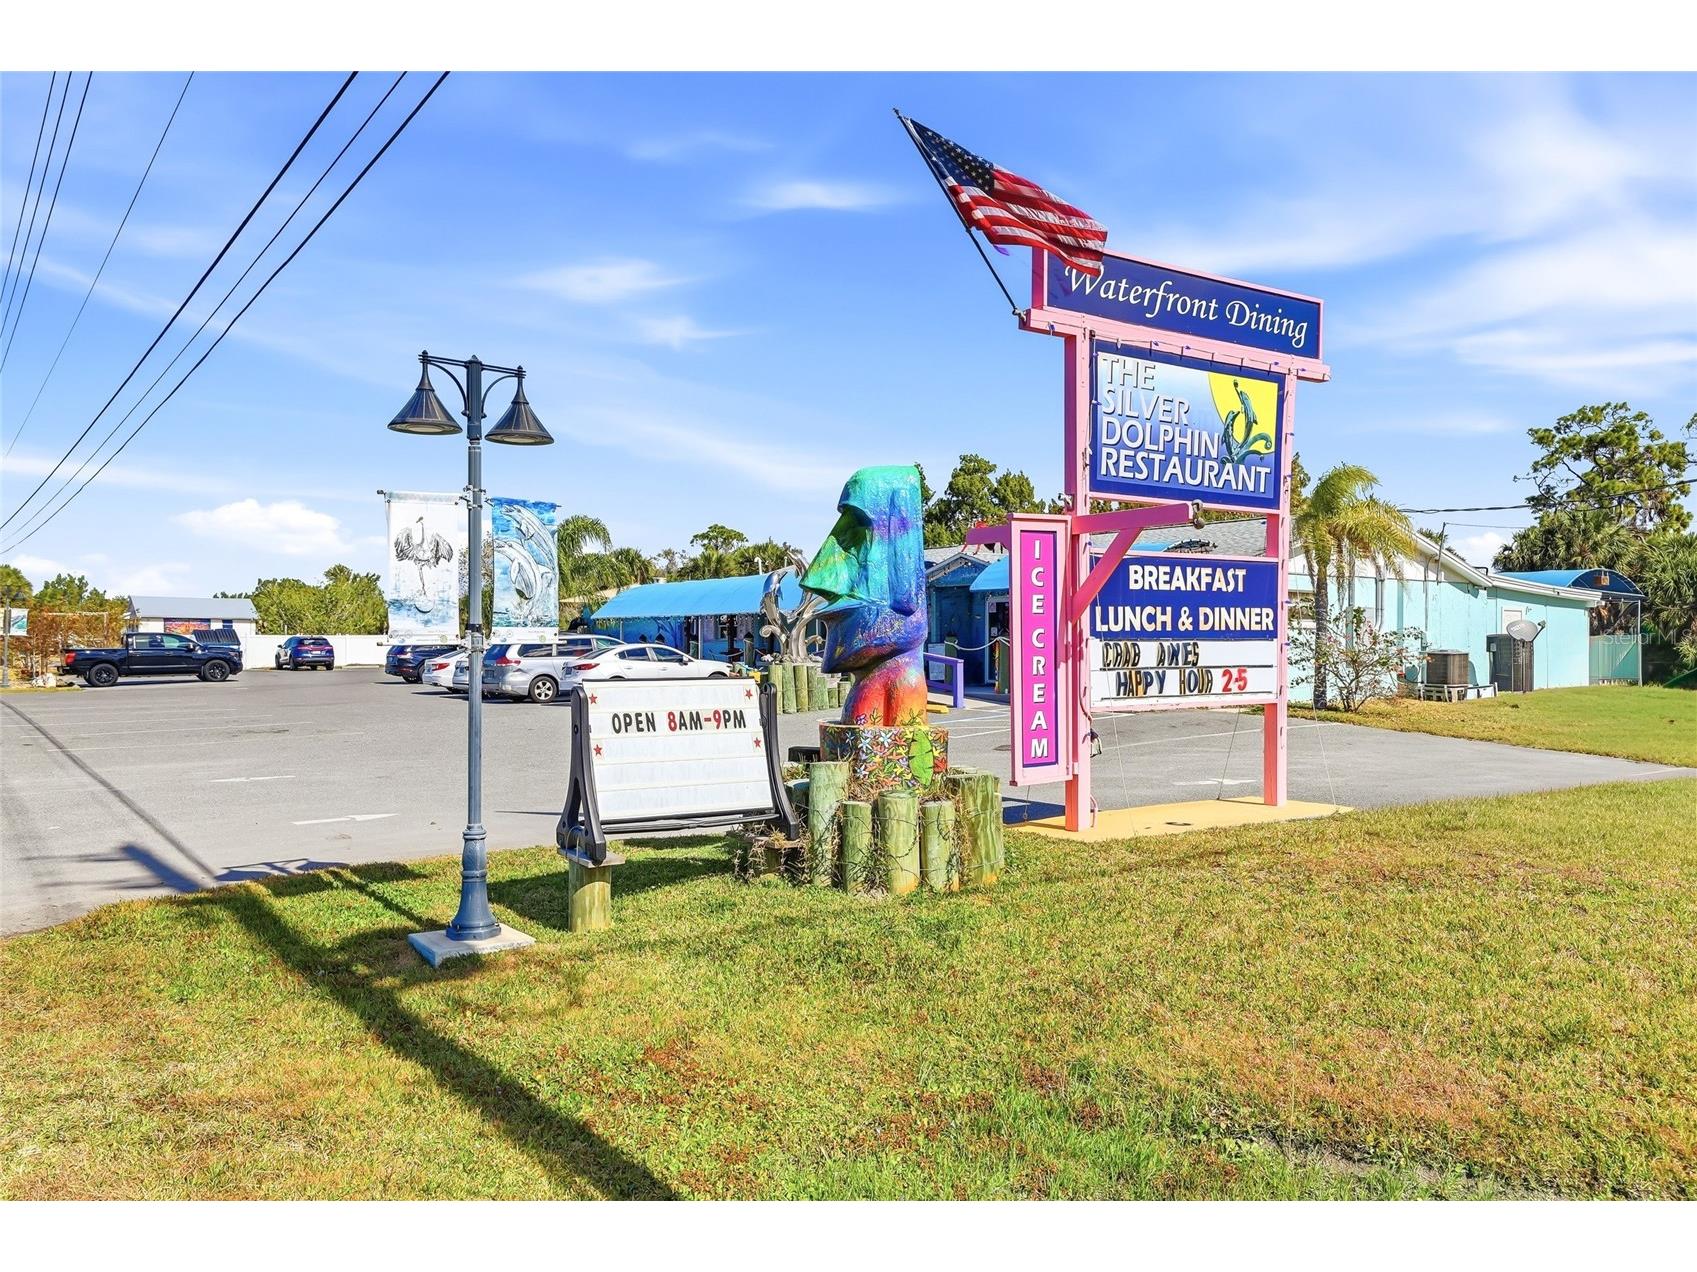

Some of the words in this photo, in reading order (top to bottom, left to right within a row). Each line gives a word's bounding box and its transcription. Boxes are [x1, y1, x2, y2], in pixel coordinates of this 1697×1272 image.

[1064, 263, 1218, 320] Waterfront
[1226, 300, 1308, 348] Dining
[1102, 357, 1156, 391] THE
[1102, 389, 1190, 426] SILVER
[1101, 417, 1220, 459] DOLPHIN
[1100, 447, 1271, 493] RESTAURANT
[1031, 539, 1045, 615] ICE
[1129, 565, 1247, 592] BREAKFAST
[1095, 606, 1172, 632] LUNCH
[1178, 607, 1193, 631] &
[1199, 607, 1274, 631] DINNER
[1102, 642, 1141, 667] CRAB
[1031, 628, 1048, 759] CREAM
[1116, 669, 1166, 696] HAPPY
[1179, 668, 1213, 694] HOUR
[1221, 667, 1248, 693] 2-5
[612, 712, 656, 734] OPEN
[667, 709, 746, 732] 8AM-9PM
